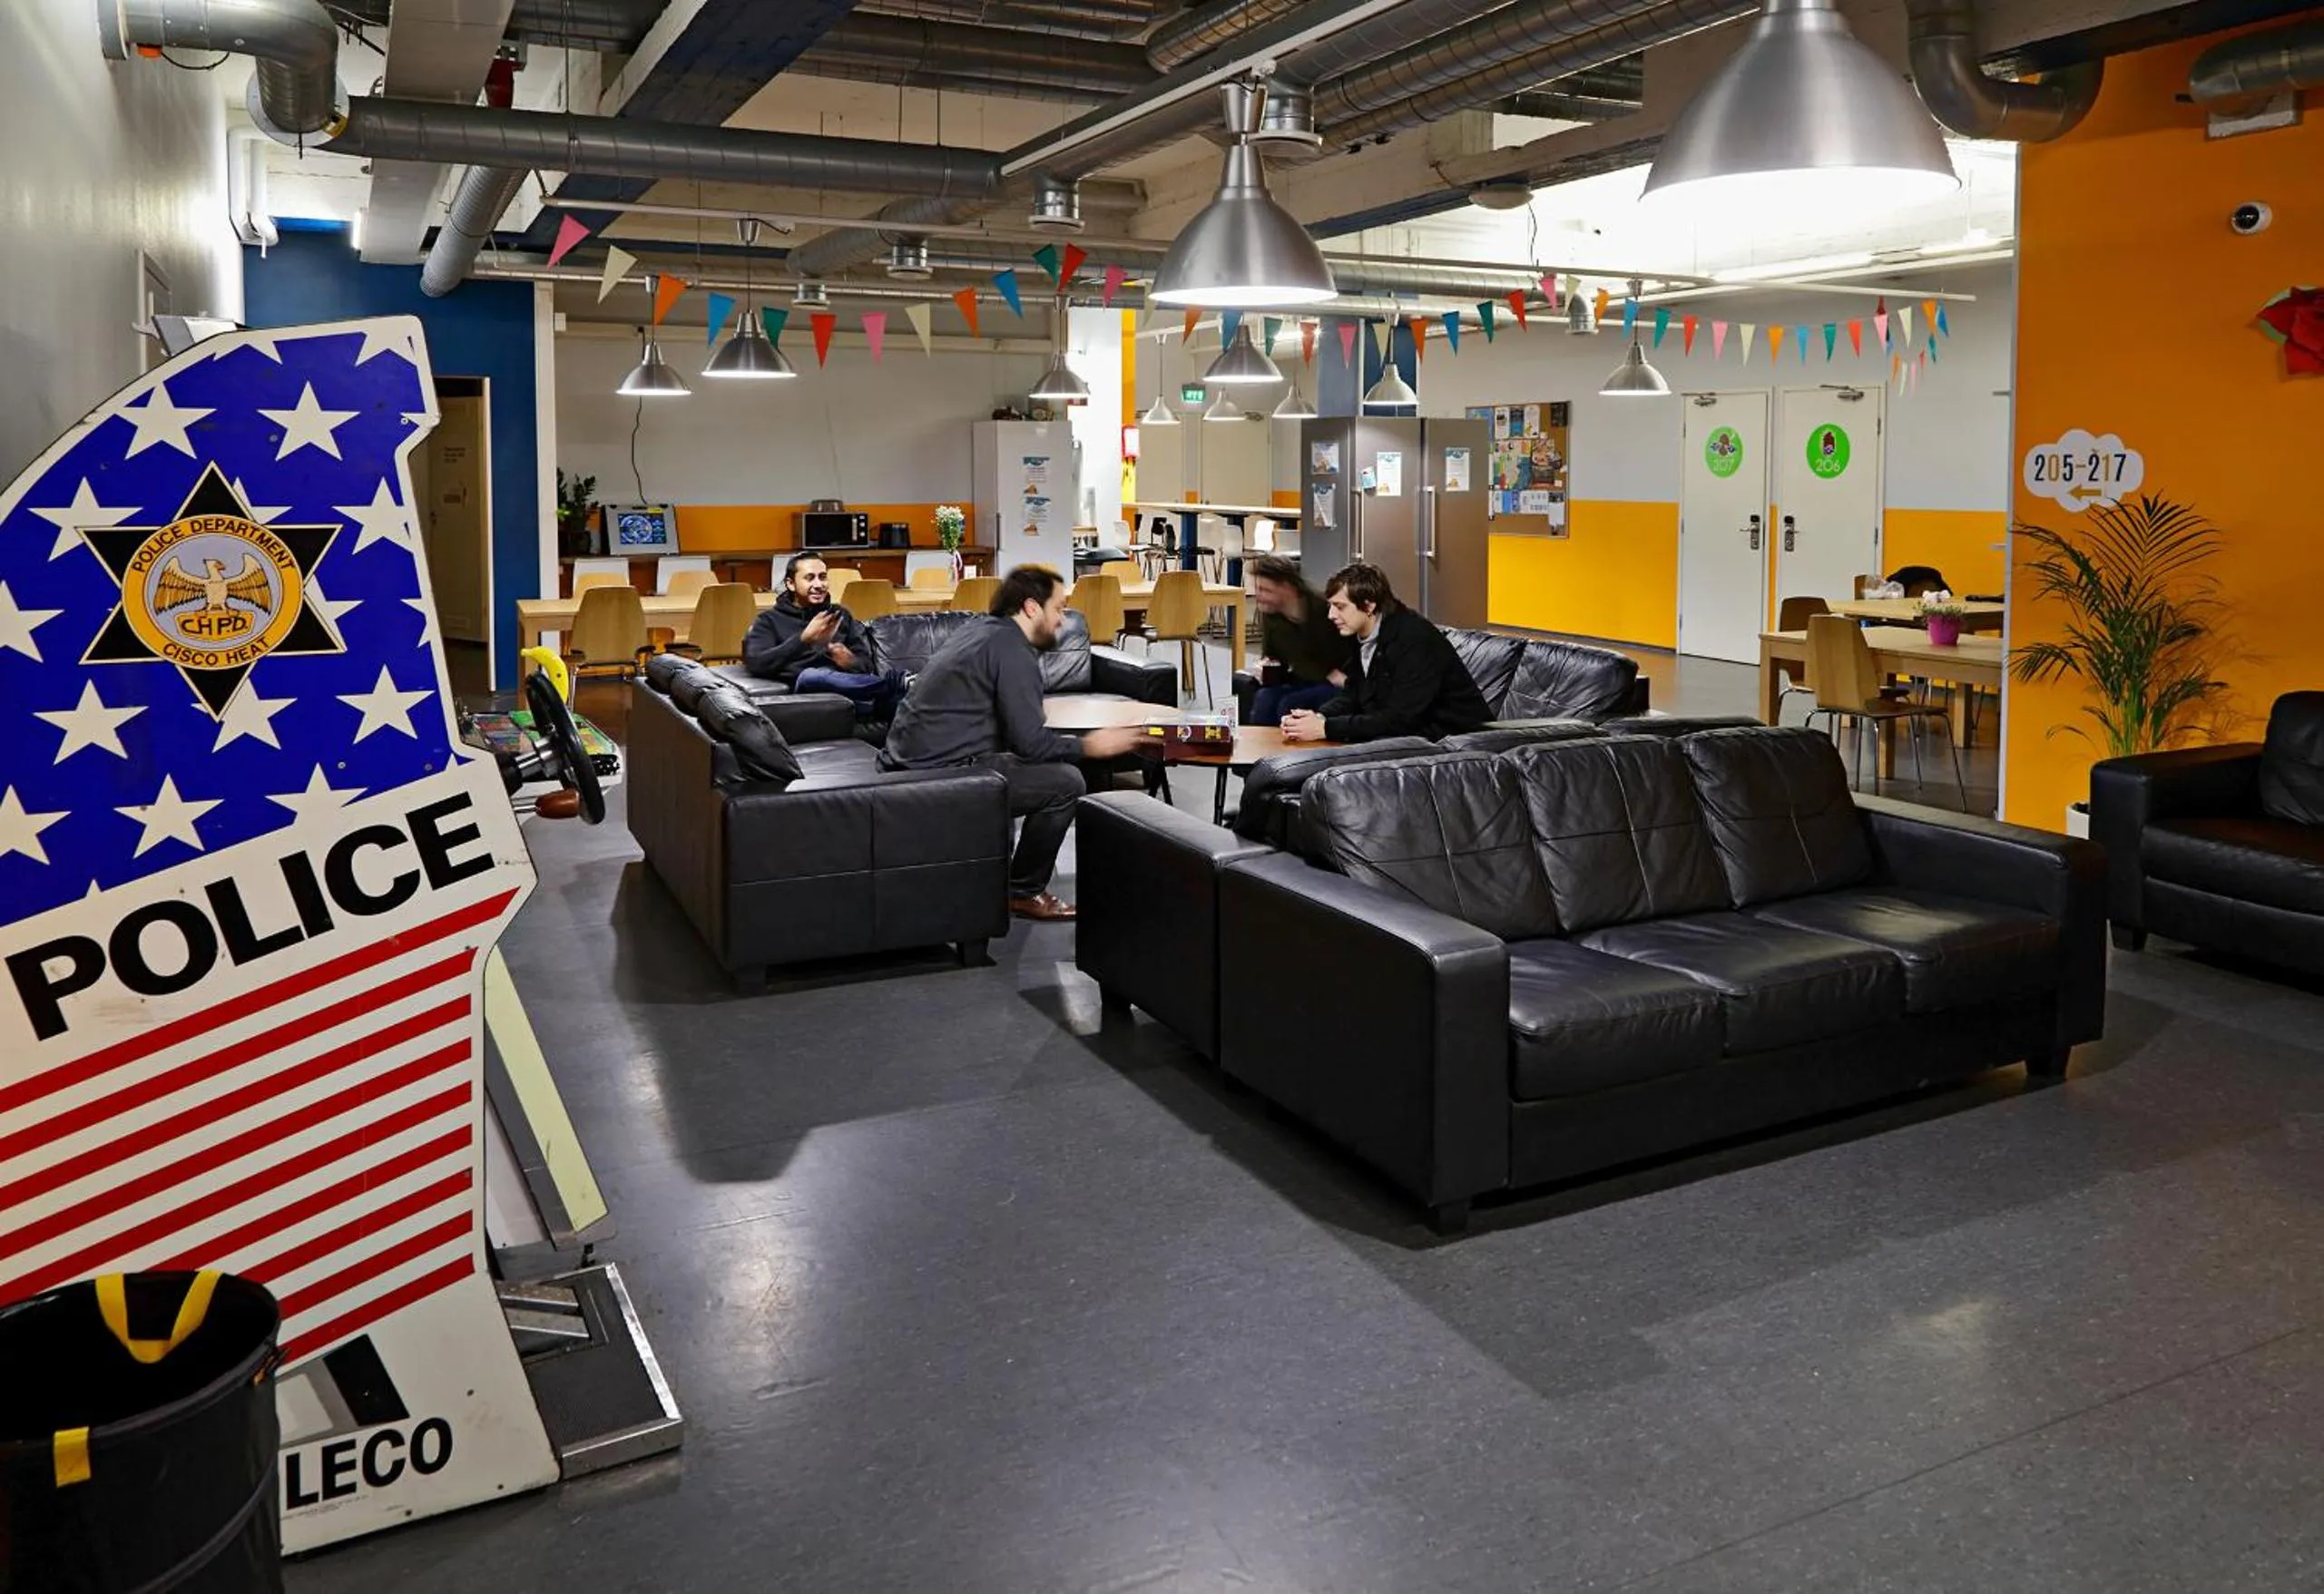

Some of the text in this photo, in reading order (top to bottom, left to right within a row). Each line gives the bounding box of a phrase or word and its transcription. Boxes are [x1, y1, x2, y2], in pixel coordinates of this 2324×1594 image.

[1815, 458, 1841, 472] 206
[2035, 454, 2126, 482] 205-217
[132, 518, 295, 572] POLICE DEPARTMENT
[162, 637, 270, 666] CISCO HEAT
[5, 791, 495, 1041] POLICE
